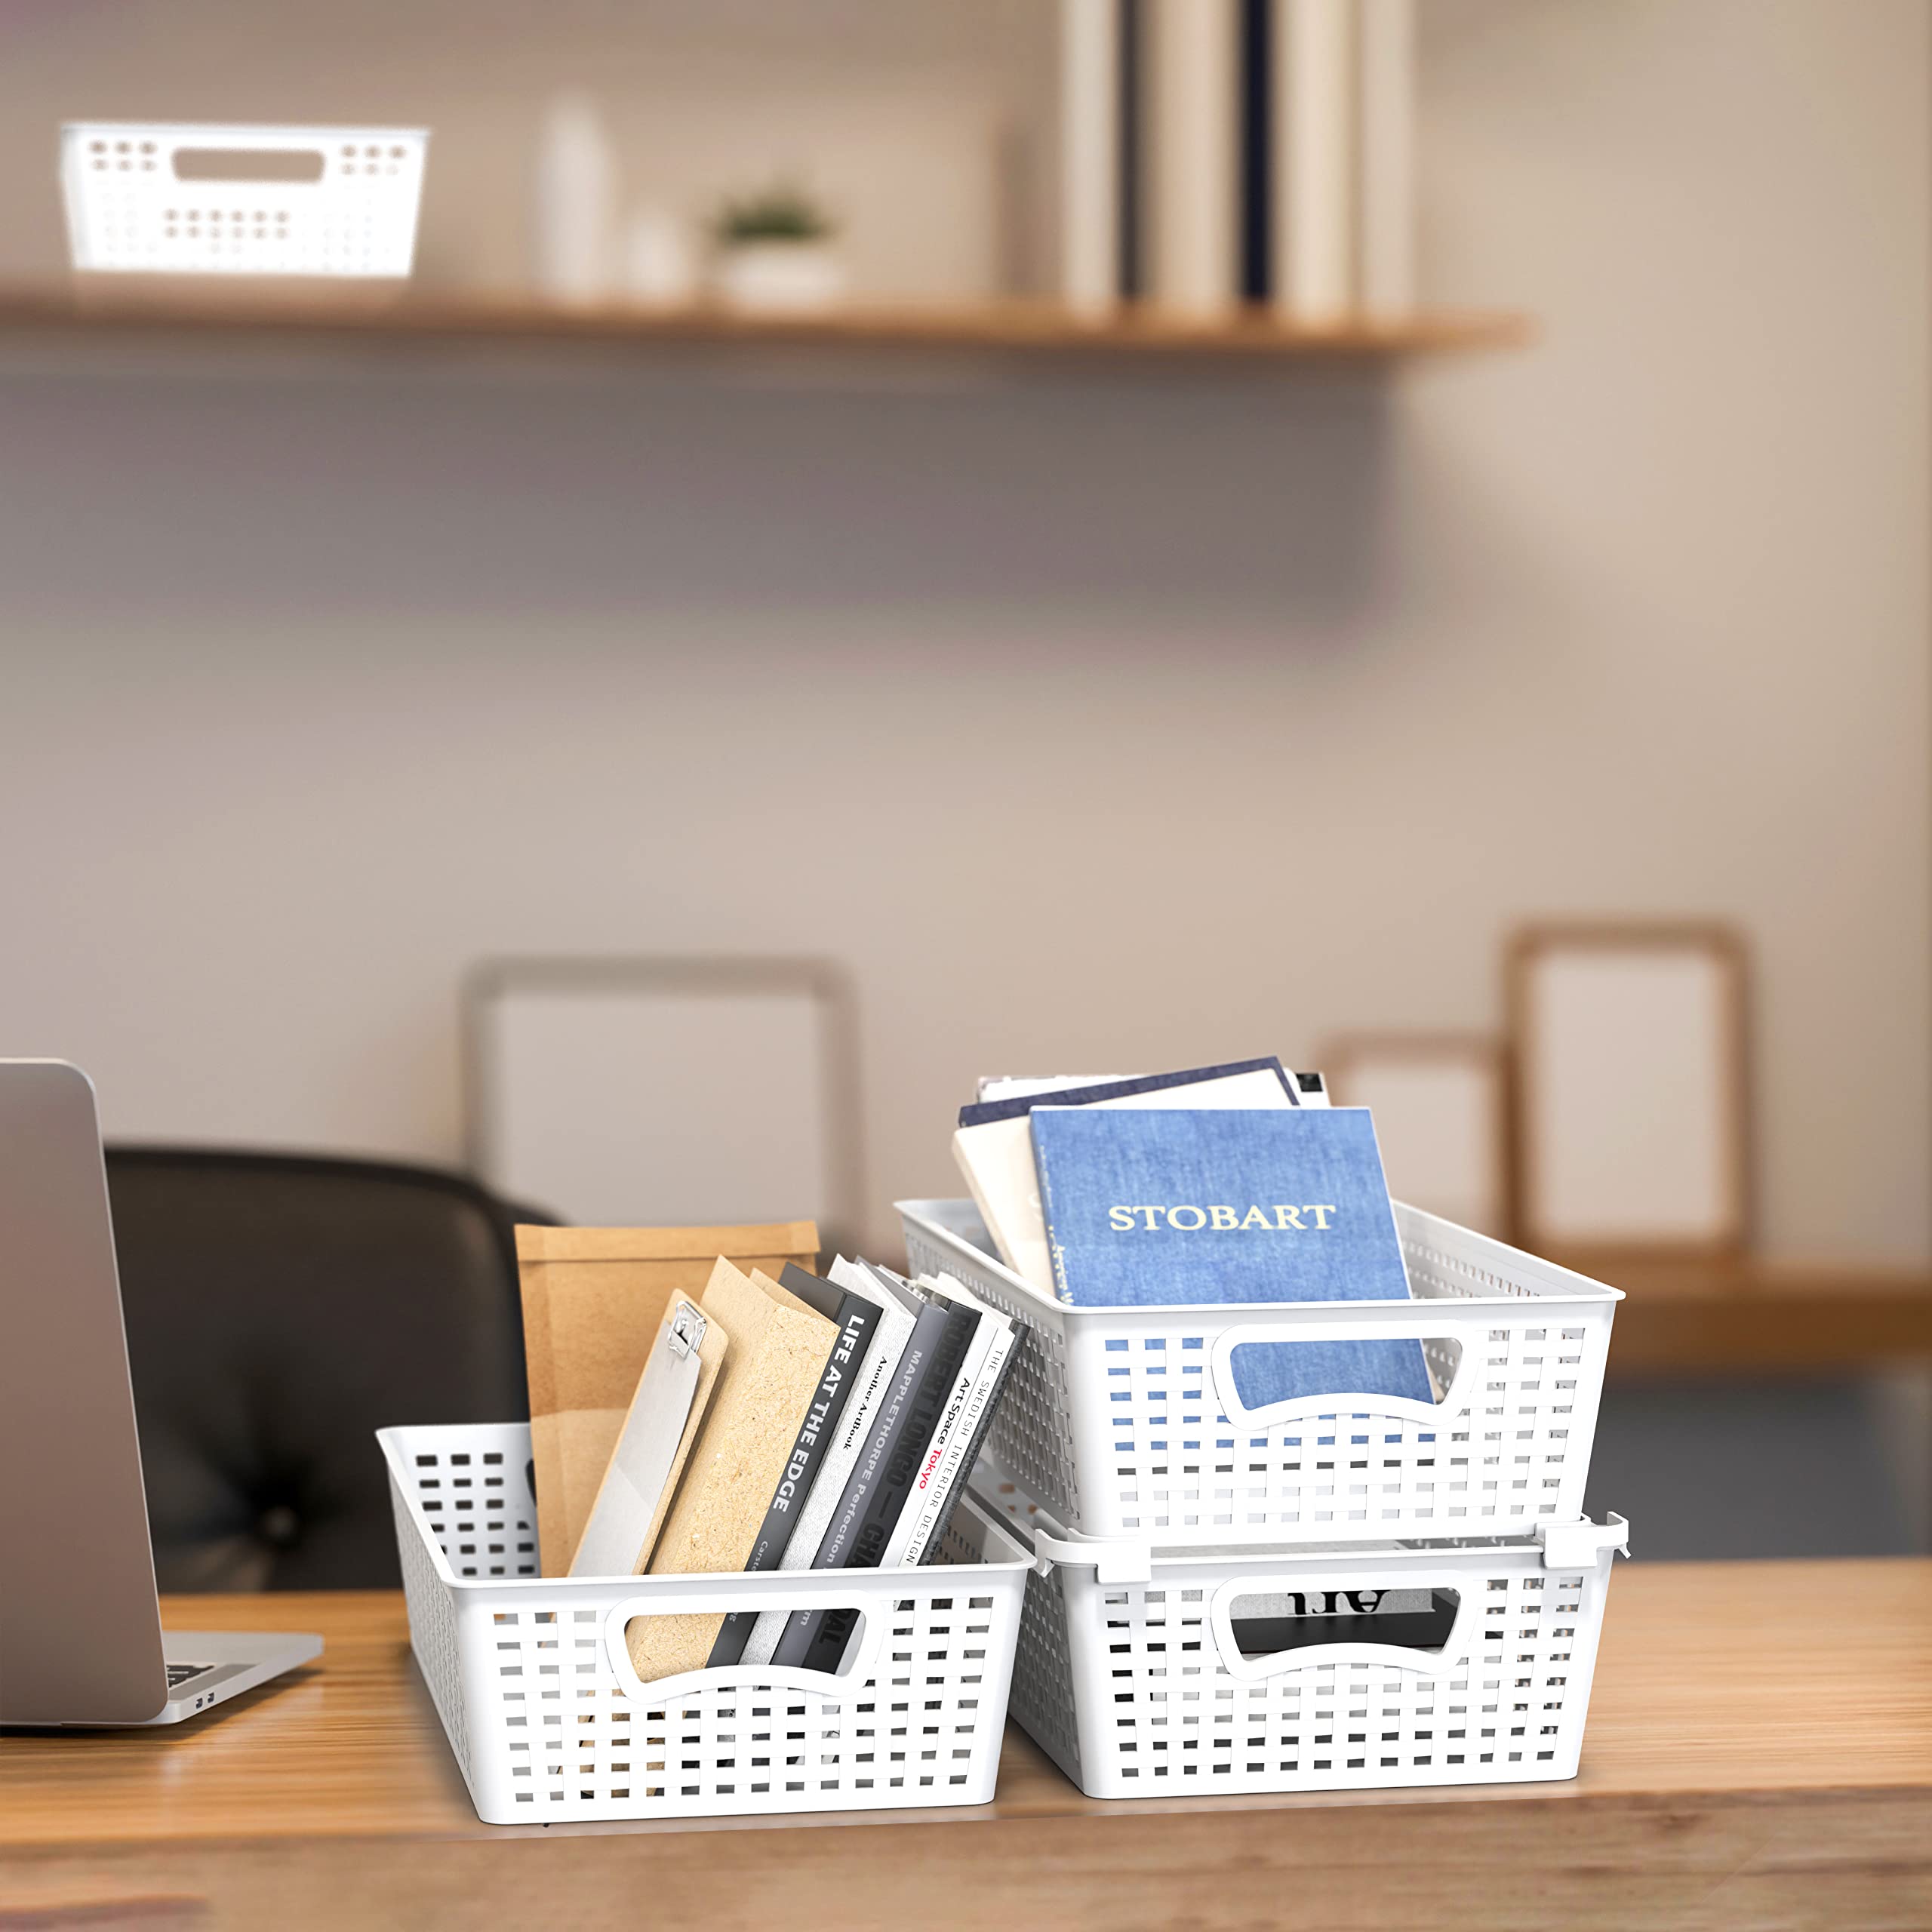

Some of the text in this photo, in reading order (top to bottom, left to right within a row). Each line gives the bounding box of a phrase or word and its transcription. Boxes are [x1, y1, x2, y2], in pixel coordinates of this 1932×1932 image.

[1109, 1204, 1336, 1231] STOBART
[773, 1315, 865, 1512] LIFE AT THE EDGE
[843, 1356, 888, 1450] Another ArtBook
[886, 1407, 933, 1487] LONGO
[826, 1350, 922, 1563] MAPPLETHORPE Perfection
[906, 1349, 1004, 1563] THE SWEDISH INTERIOR DESIGN
[919, 1449, 943, 1490] Tokyo
